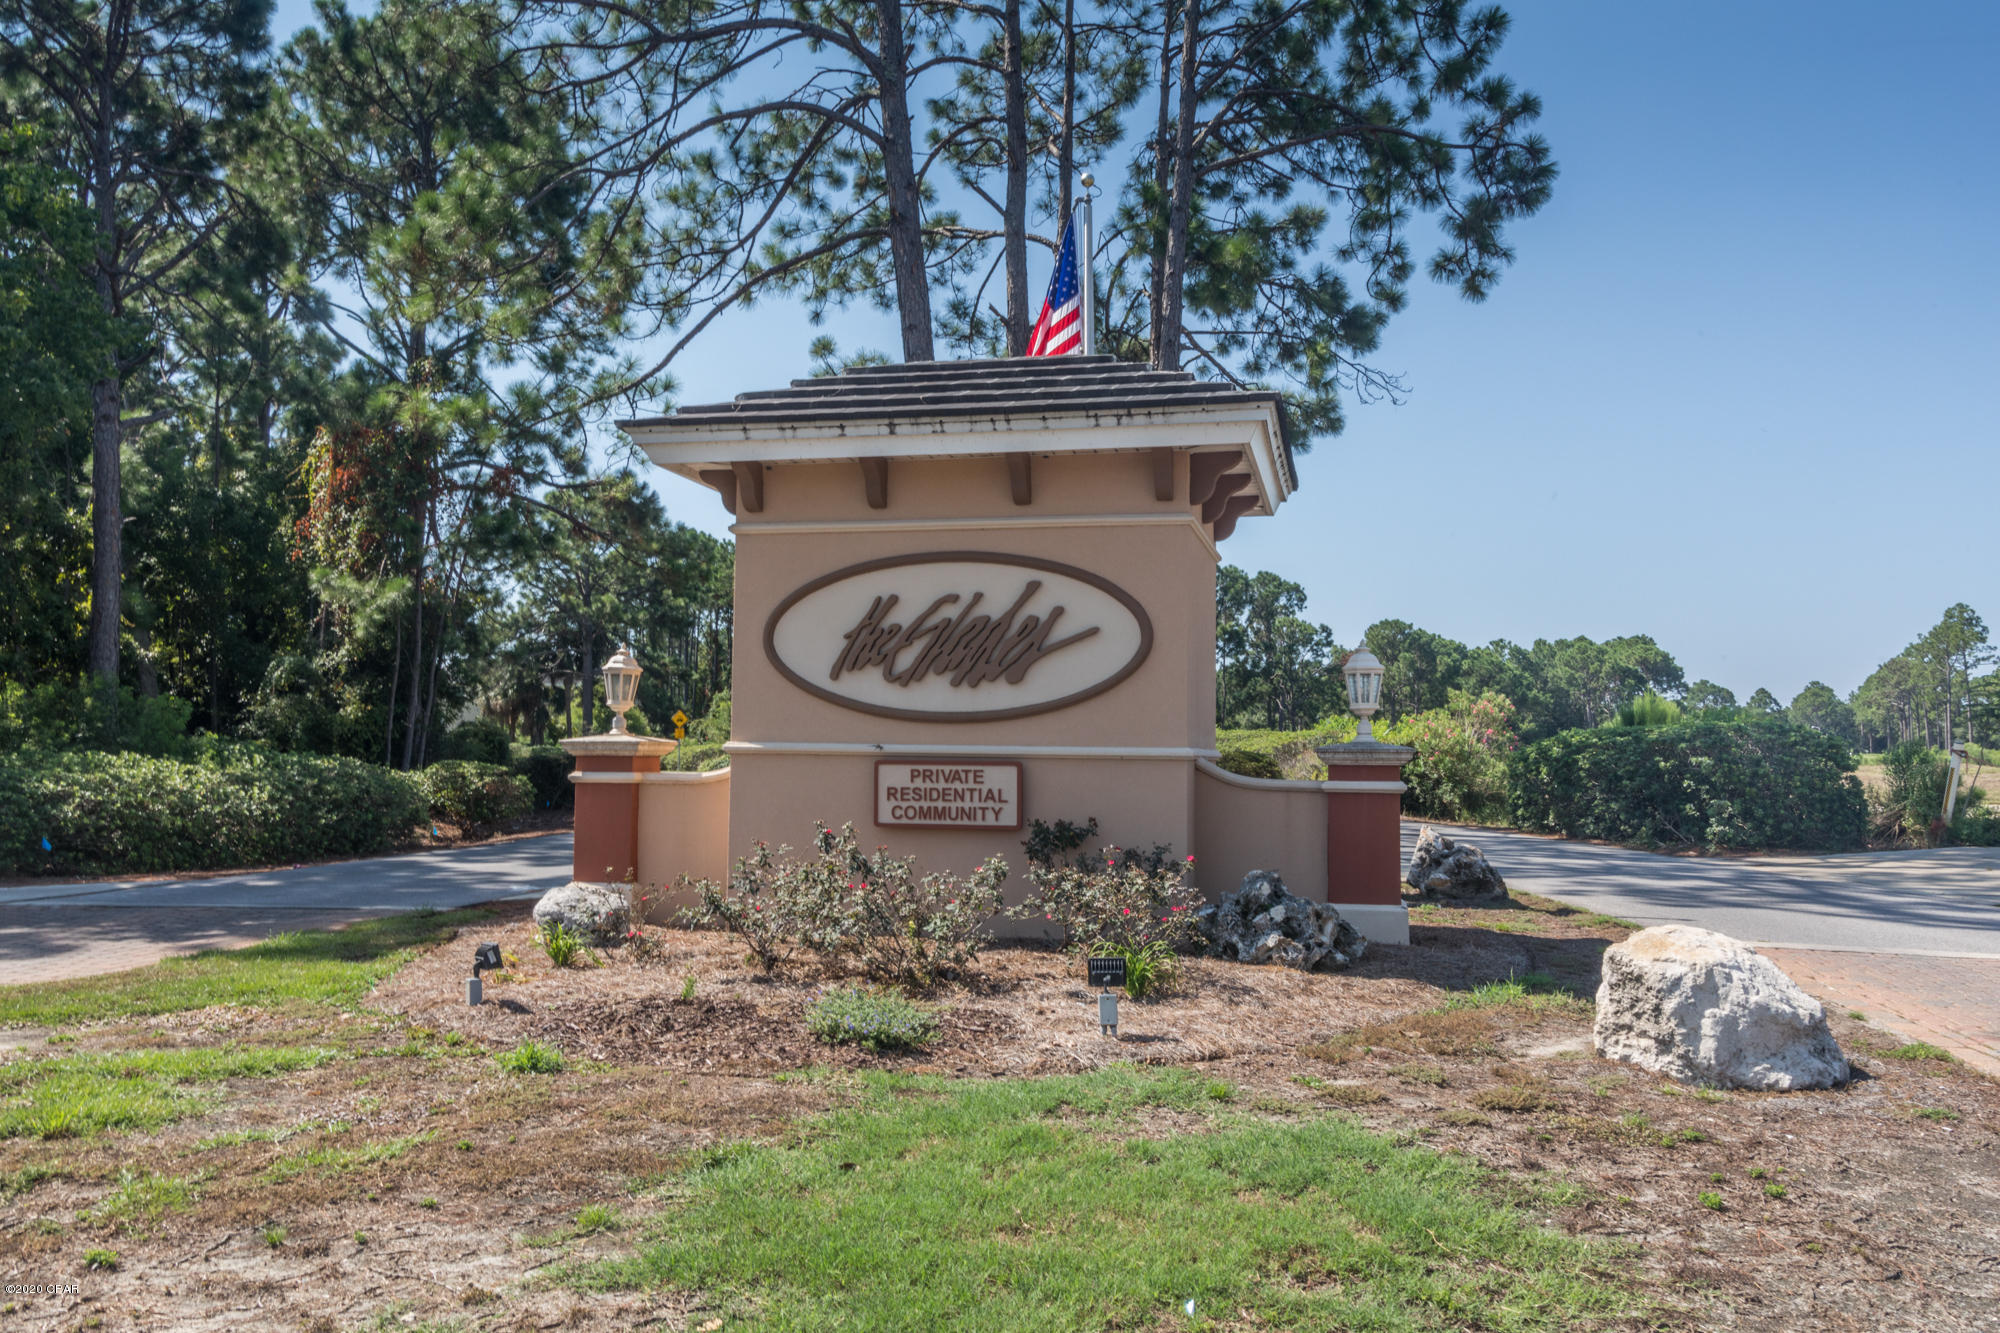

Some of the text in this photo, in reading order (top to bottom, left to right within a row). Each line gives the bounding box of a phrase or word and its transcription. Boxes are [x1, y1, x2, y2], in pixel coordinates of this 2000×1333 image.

[910, 768, 985, 785] PRIVATE
[886, 786, 1009, 804] RESIDENTIAL
[891, 804, 1004, 822] COMMUNITY
